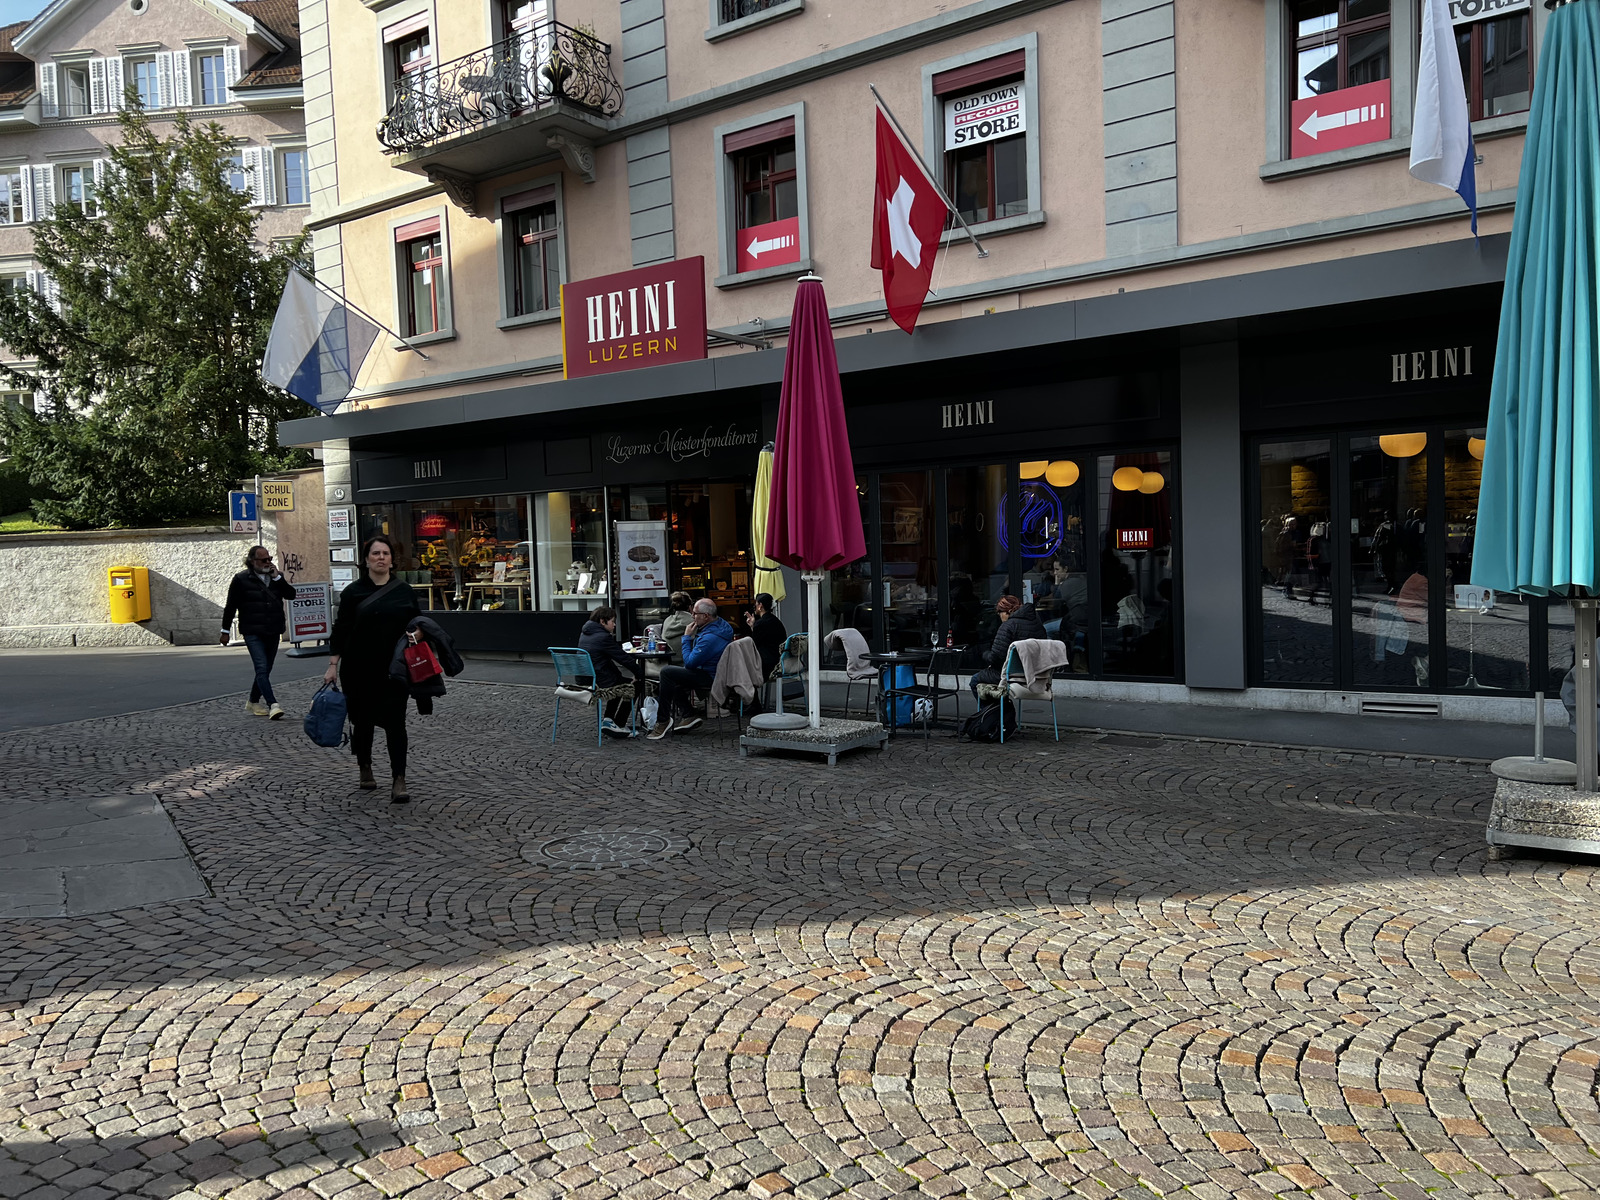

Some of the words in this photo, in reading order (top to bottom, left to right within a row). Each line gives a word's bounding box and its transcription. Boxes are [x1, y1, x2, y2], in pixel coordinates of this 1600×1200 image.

[954, 97, 980, 112] OLD
[981, 86, 1019, 105] TOWN
[955, 101, 1018, 124] RECORD
[954, 114, 1020, 144] STORE
[586, 280, 677, 343] HEINI
[589, 336, 677, 364] LUZERN
[1391, 345, 1473, 382] HEINI
[942, 400, 994, 428] HEINI
[606, 436, 652, 463] Luzerns
[654, 423, 758, 462] Meisterkonditorei
[414, 459, 442, 479] HEINI
[264, 485, 291, 495] SCHUL
[267, 498, 289, 507] ZONE
[1122, 530, 1148, 542] HEINI
[293, 598, 326, 608] STORE
[294, 614, 317, 623] COME
